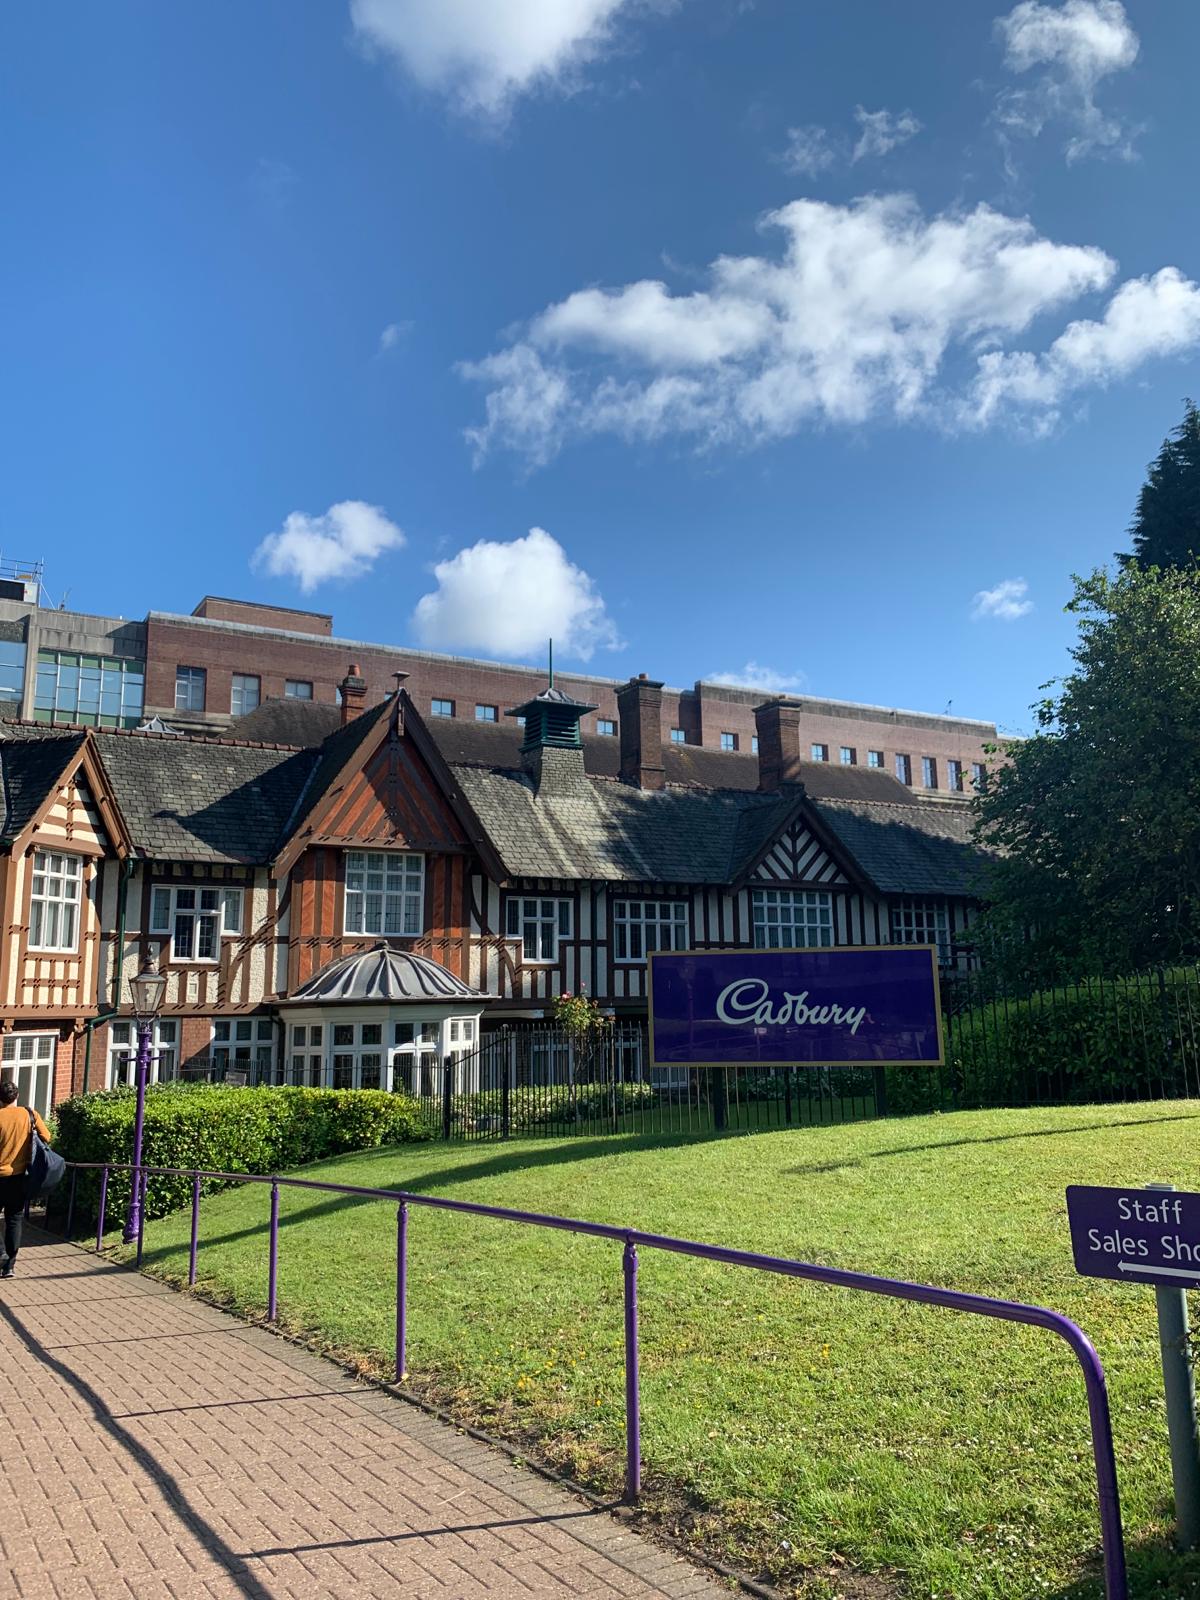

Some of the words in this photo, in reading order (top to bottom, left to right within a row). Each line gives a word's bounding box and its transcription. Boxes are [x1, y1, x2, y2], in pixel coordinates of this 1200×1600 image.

[716, 978, 866, 1035] Cadbury
[1117, 1197, 1182, 1224] Staff
[1088, 1228, 1149, 1256] Sales
